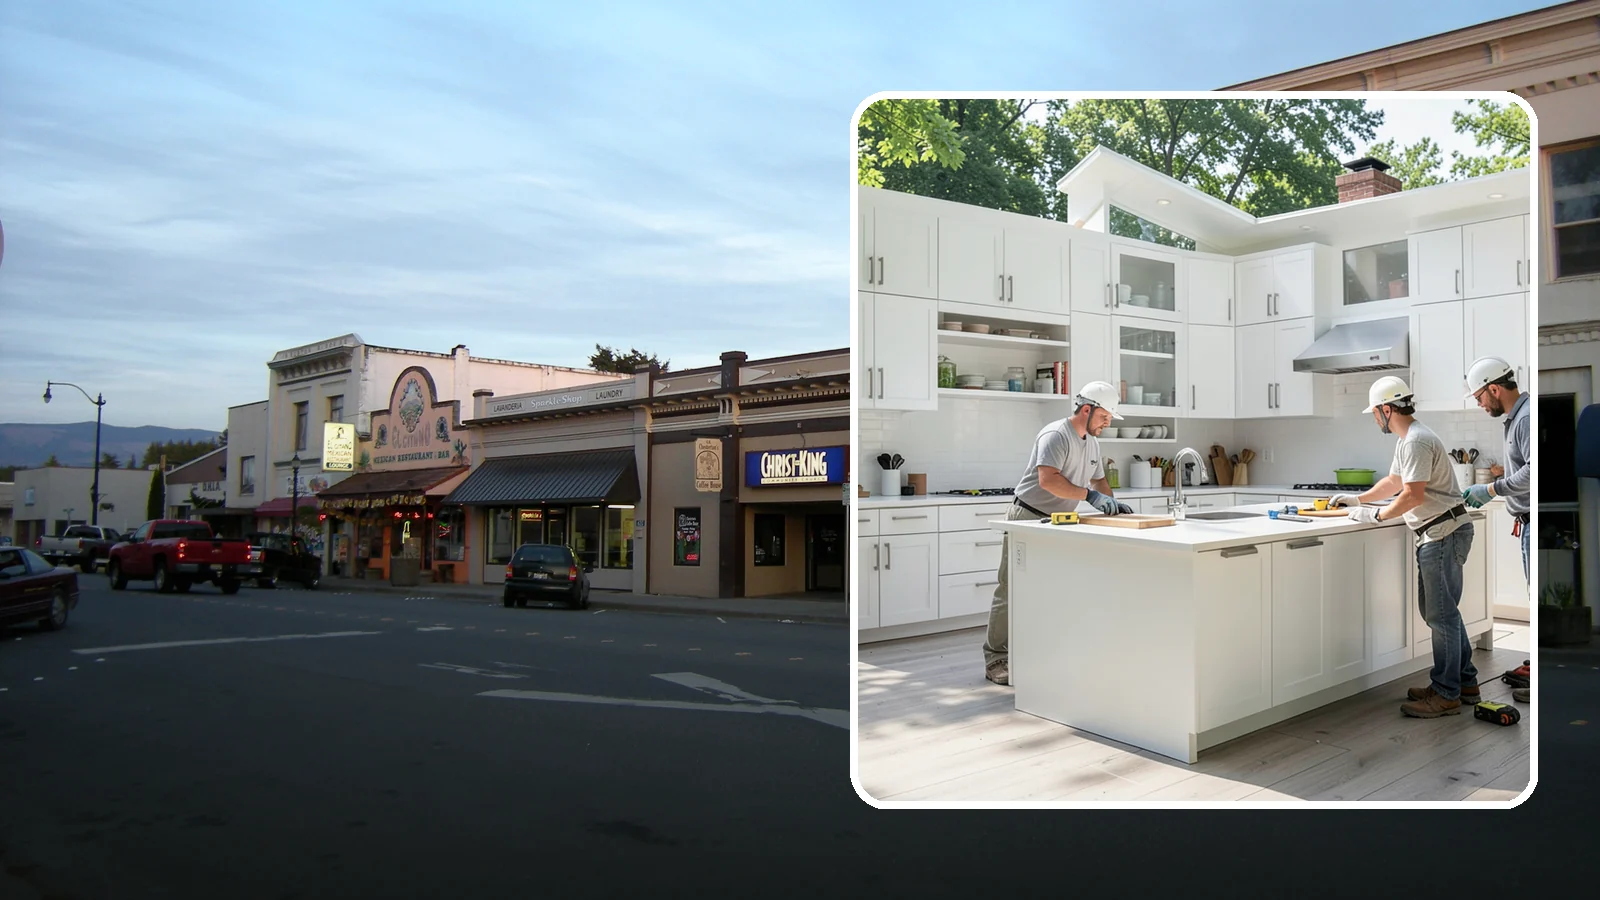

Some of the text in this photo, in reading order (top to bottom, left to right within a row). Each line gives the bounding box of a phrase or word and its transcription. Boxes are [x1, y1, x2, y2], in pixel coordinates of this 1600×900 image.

[531, 394, 582, 409] Sparkle Shop
[596, 389, 623, 400] LAUNDRY
[493, 402, 522, 412] LAVANDERIA
[373, 454, 396, 464] MEXICAN
[397, 451, 434, 463] RESTAURANT
[437, 450, 450, 459] BAR
[760, 450, 827, 478] CHRIST KING
